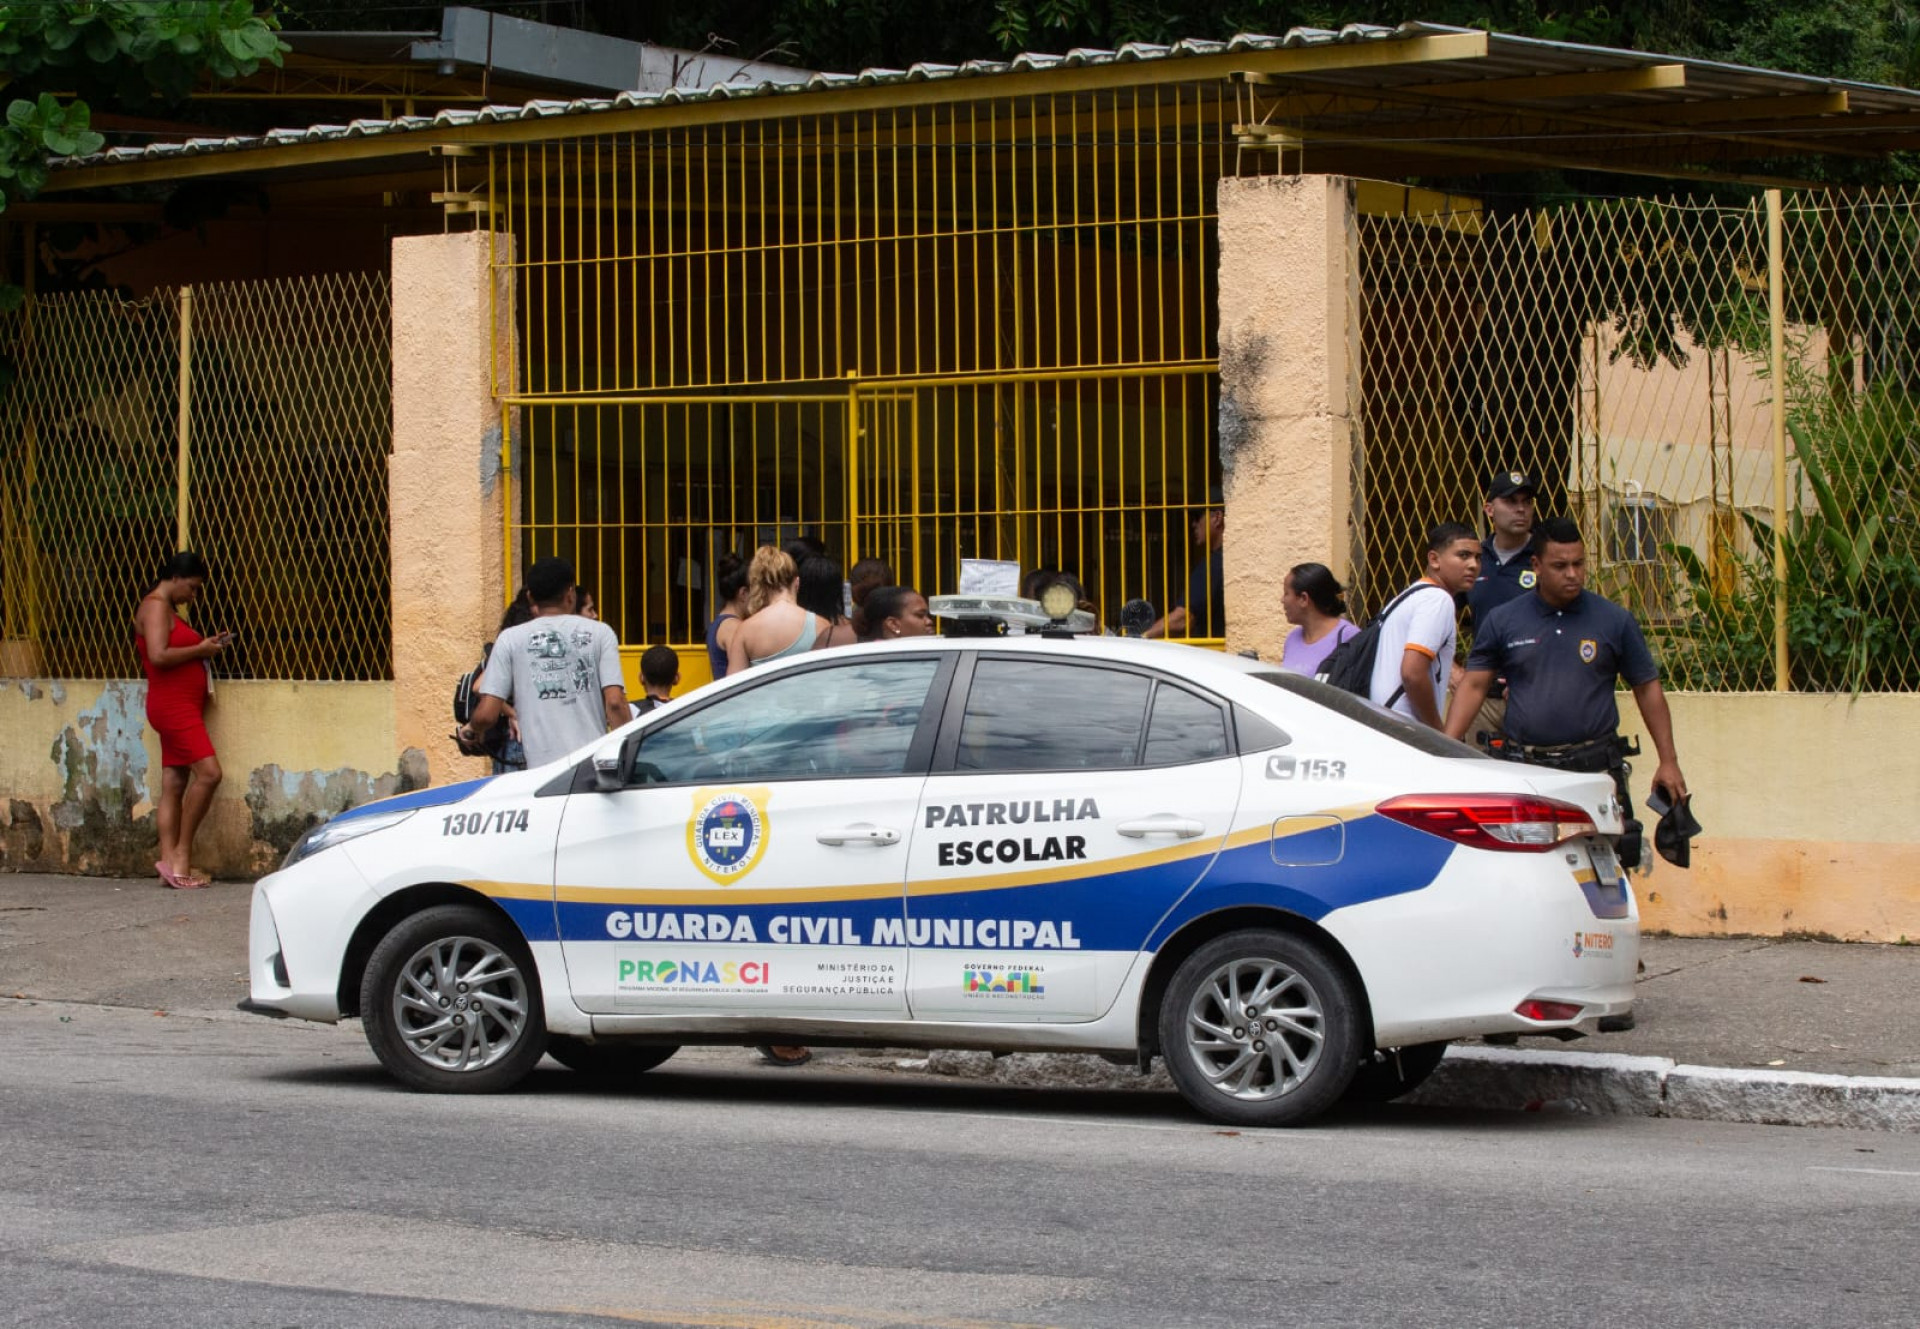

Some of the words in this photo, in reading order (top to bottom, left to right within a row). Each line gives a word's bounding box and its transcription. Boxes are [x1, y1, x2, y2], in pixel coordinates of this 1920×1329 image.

[1299, 758, 1346, 781] 153
[442, 808, 530, 836] 130/174
[924, 797, 1101, 829] PATRULHA
[714, 831, 739, 841] LEX
[938, 835, 1087, 867] ESCOLAR
[605, 910, 758, 942] GUARDA
[768, 915, 861, 945] CIVIL
[871, 917, 1081, 949] MUNICIPAL
[618, 959, 769, 985] PRONASCI
[817, 962, 878, 972] MINISTÉRIO
[880, 964, 895, 973] DA
[964, 963, 1005, 971] GOVERNO
[1007, 964, 1045, 972] FEDERAL
[782, 985, 847, 995] SEGURANÇA
[842, 975, 886, 984] JUSTIÇA
[888, 975, 894, 984] E
[963, 971, 1045, 993] BRASIL
